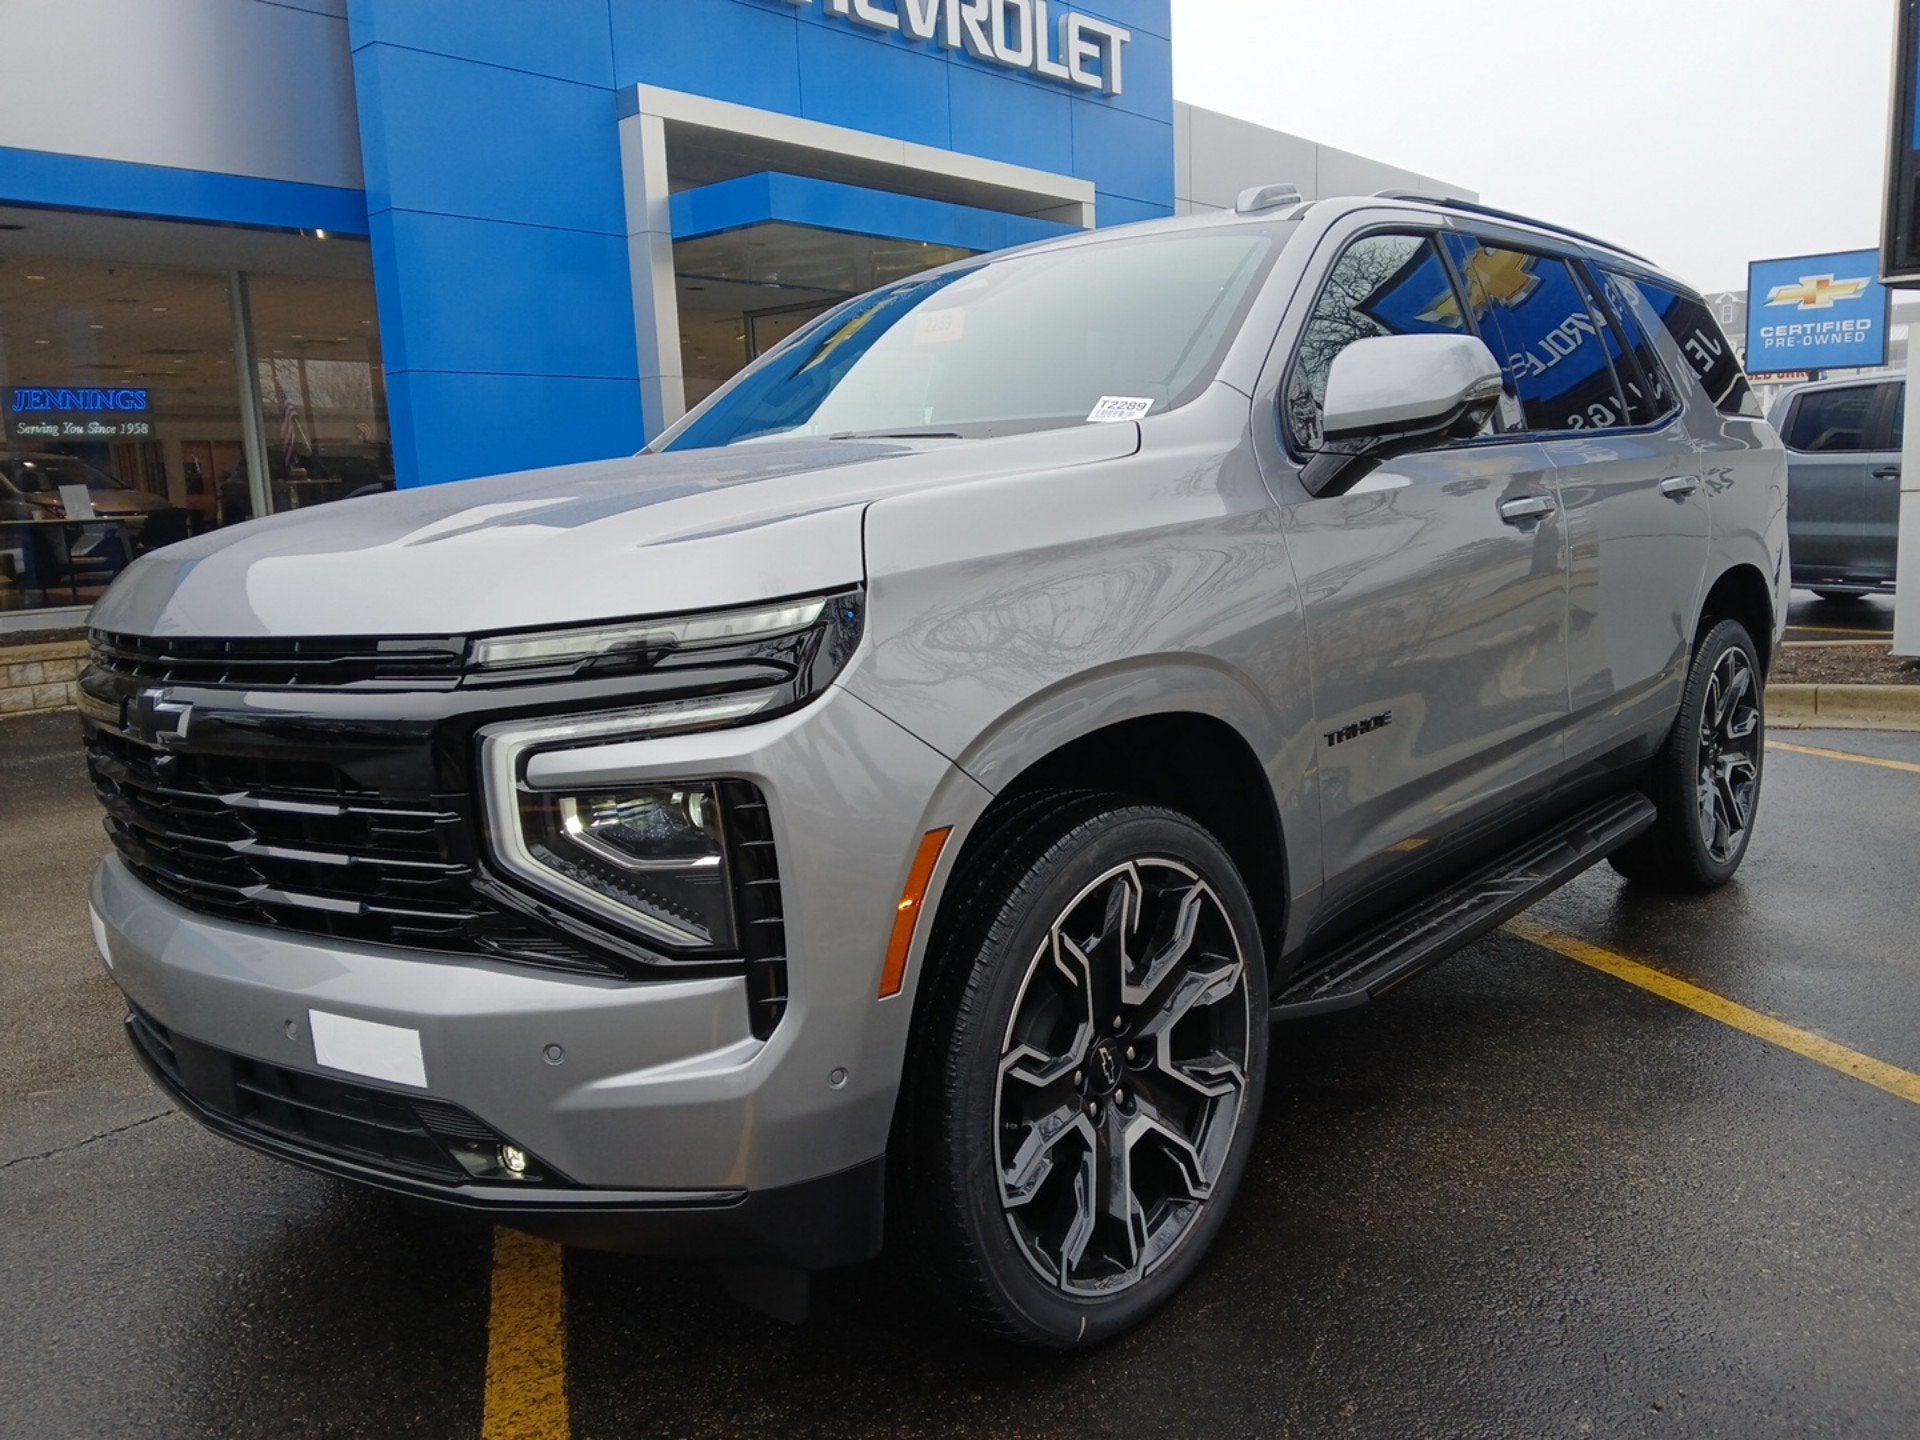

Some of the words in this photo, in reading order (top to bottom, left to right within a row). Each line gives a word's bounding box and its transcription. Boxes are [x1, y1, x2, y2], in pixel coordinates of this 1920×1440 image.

[1760, 318, 1872, 338] CERTIFIED
[1764, 331, 1865, 349] PRE-OWNED
[12, 389, 147, 412] JENNINGS
[1100, 399, 1148, 411] T2289
[17, 422, 60, 436] Serving
[62, 422, 84, 434] You
[87, 421, 117, 434] Since
[119, 423, 149, 434] 1958
[1323, 710, 1392, 747] TAHOE
